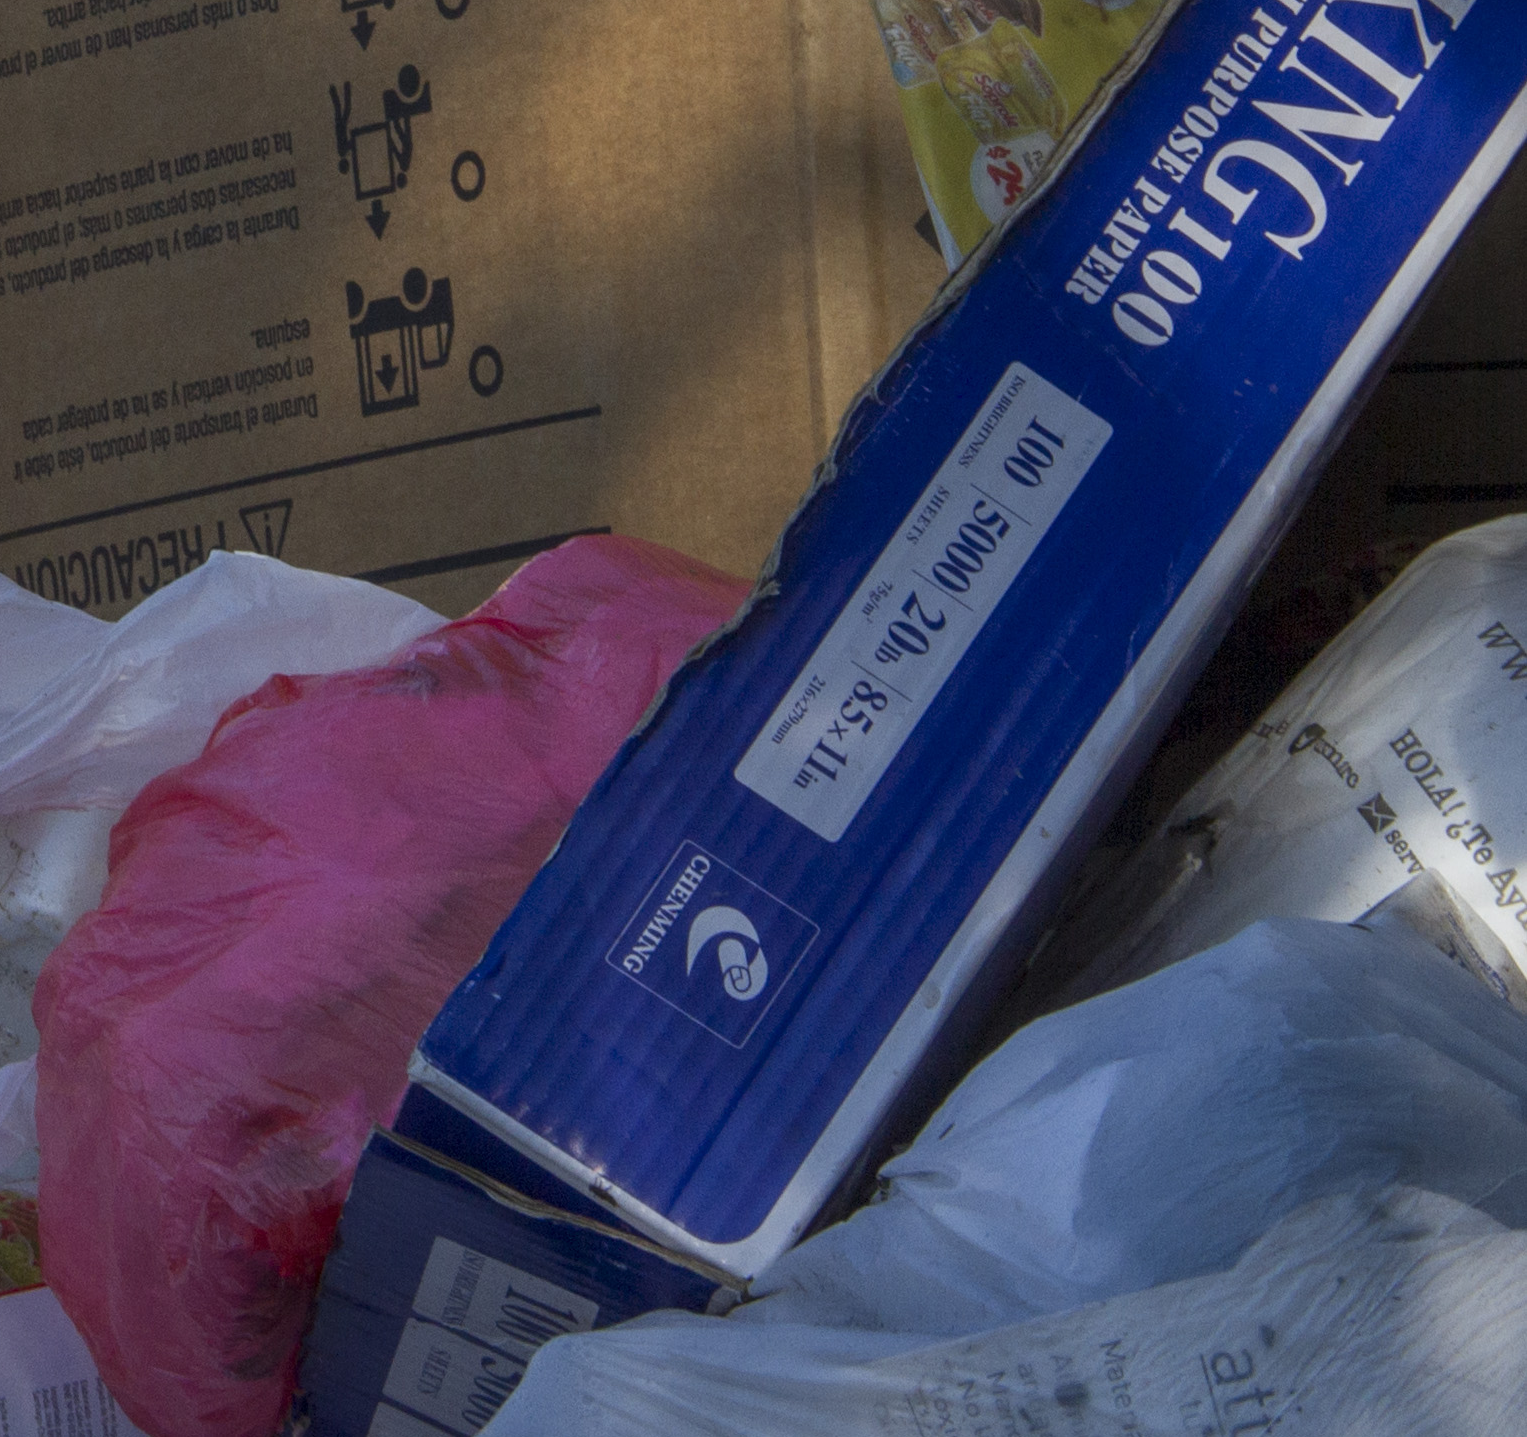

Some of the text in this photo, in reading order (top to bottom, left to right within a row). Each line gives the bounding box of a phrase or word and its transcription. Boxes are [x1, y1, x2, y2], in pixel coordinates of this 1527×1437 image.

[134, 4, 198, 41] personas
[202, 0, 233, 29] más
[85, 33, 102, 57] de
[105, 26, 132, 49] han
[24, 50, 37, 75] el
[41, 40, 82, 67] mover
[1152, 9, 1286, 182] PURPOSE
[205, 142, 248, 170] mover
[252, 136, 270, 160] de
[273, 131, 293, 154] ha
[120, 159, 155, 191] parte
[158, 160, 172, 183] la
[174, 153, 200, 177] con
[65, 173, 117, 205] superior
[190, 187, 216, 212] dos
[219, 169, 296, 205] necesarias
[25, 188, 61, 215] hacia
[126, 190, 187, 226] personas
[114, 209, 123, 230] o
[226, 220, 240, 243] la
[243, 206, 299, 237] Durante
[5, 221, 60, 257] producto
[63, 222, 75, 247] el
[173, 228, 181, 252] y
[183, 224, 222, 250] carga
[1066, 177, 1171, 303] PAPER
[92, 240, 153, 271] descarga
[155, 237, 170, 260] la
[69, 256, 90, 283] del
[295, 356, 314, 377] en
[131, 394, 150, 416] ha
[152, 389, 167, 410] se
[172, 381, 180, 406] y
[182, 376, 231, 407] vertical
[57, 399, 109, 432] proteger
[112, 398, 129, 422] de
[245, 407, 258, 431] el
[262, 394, 318, 424] Durante
[958, 374, 1027, 466] ISO BRIGHTNESS
[22, 416, 53, 442] cada
[150, 426, 170, 453] del
[175, 411, 243, 443] transporte
[1003, 418, 1064, 487] 100
[14, 461, 23, 483] ir
[24, 454, 54, 479] debe
[906, 485, 950, 545] SHEETS
[932, 500, 1010, 593] 5000
[1390, 727, 1464, 818] HOLA!
[623, 855, 710, 973] CHENMING
